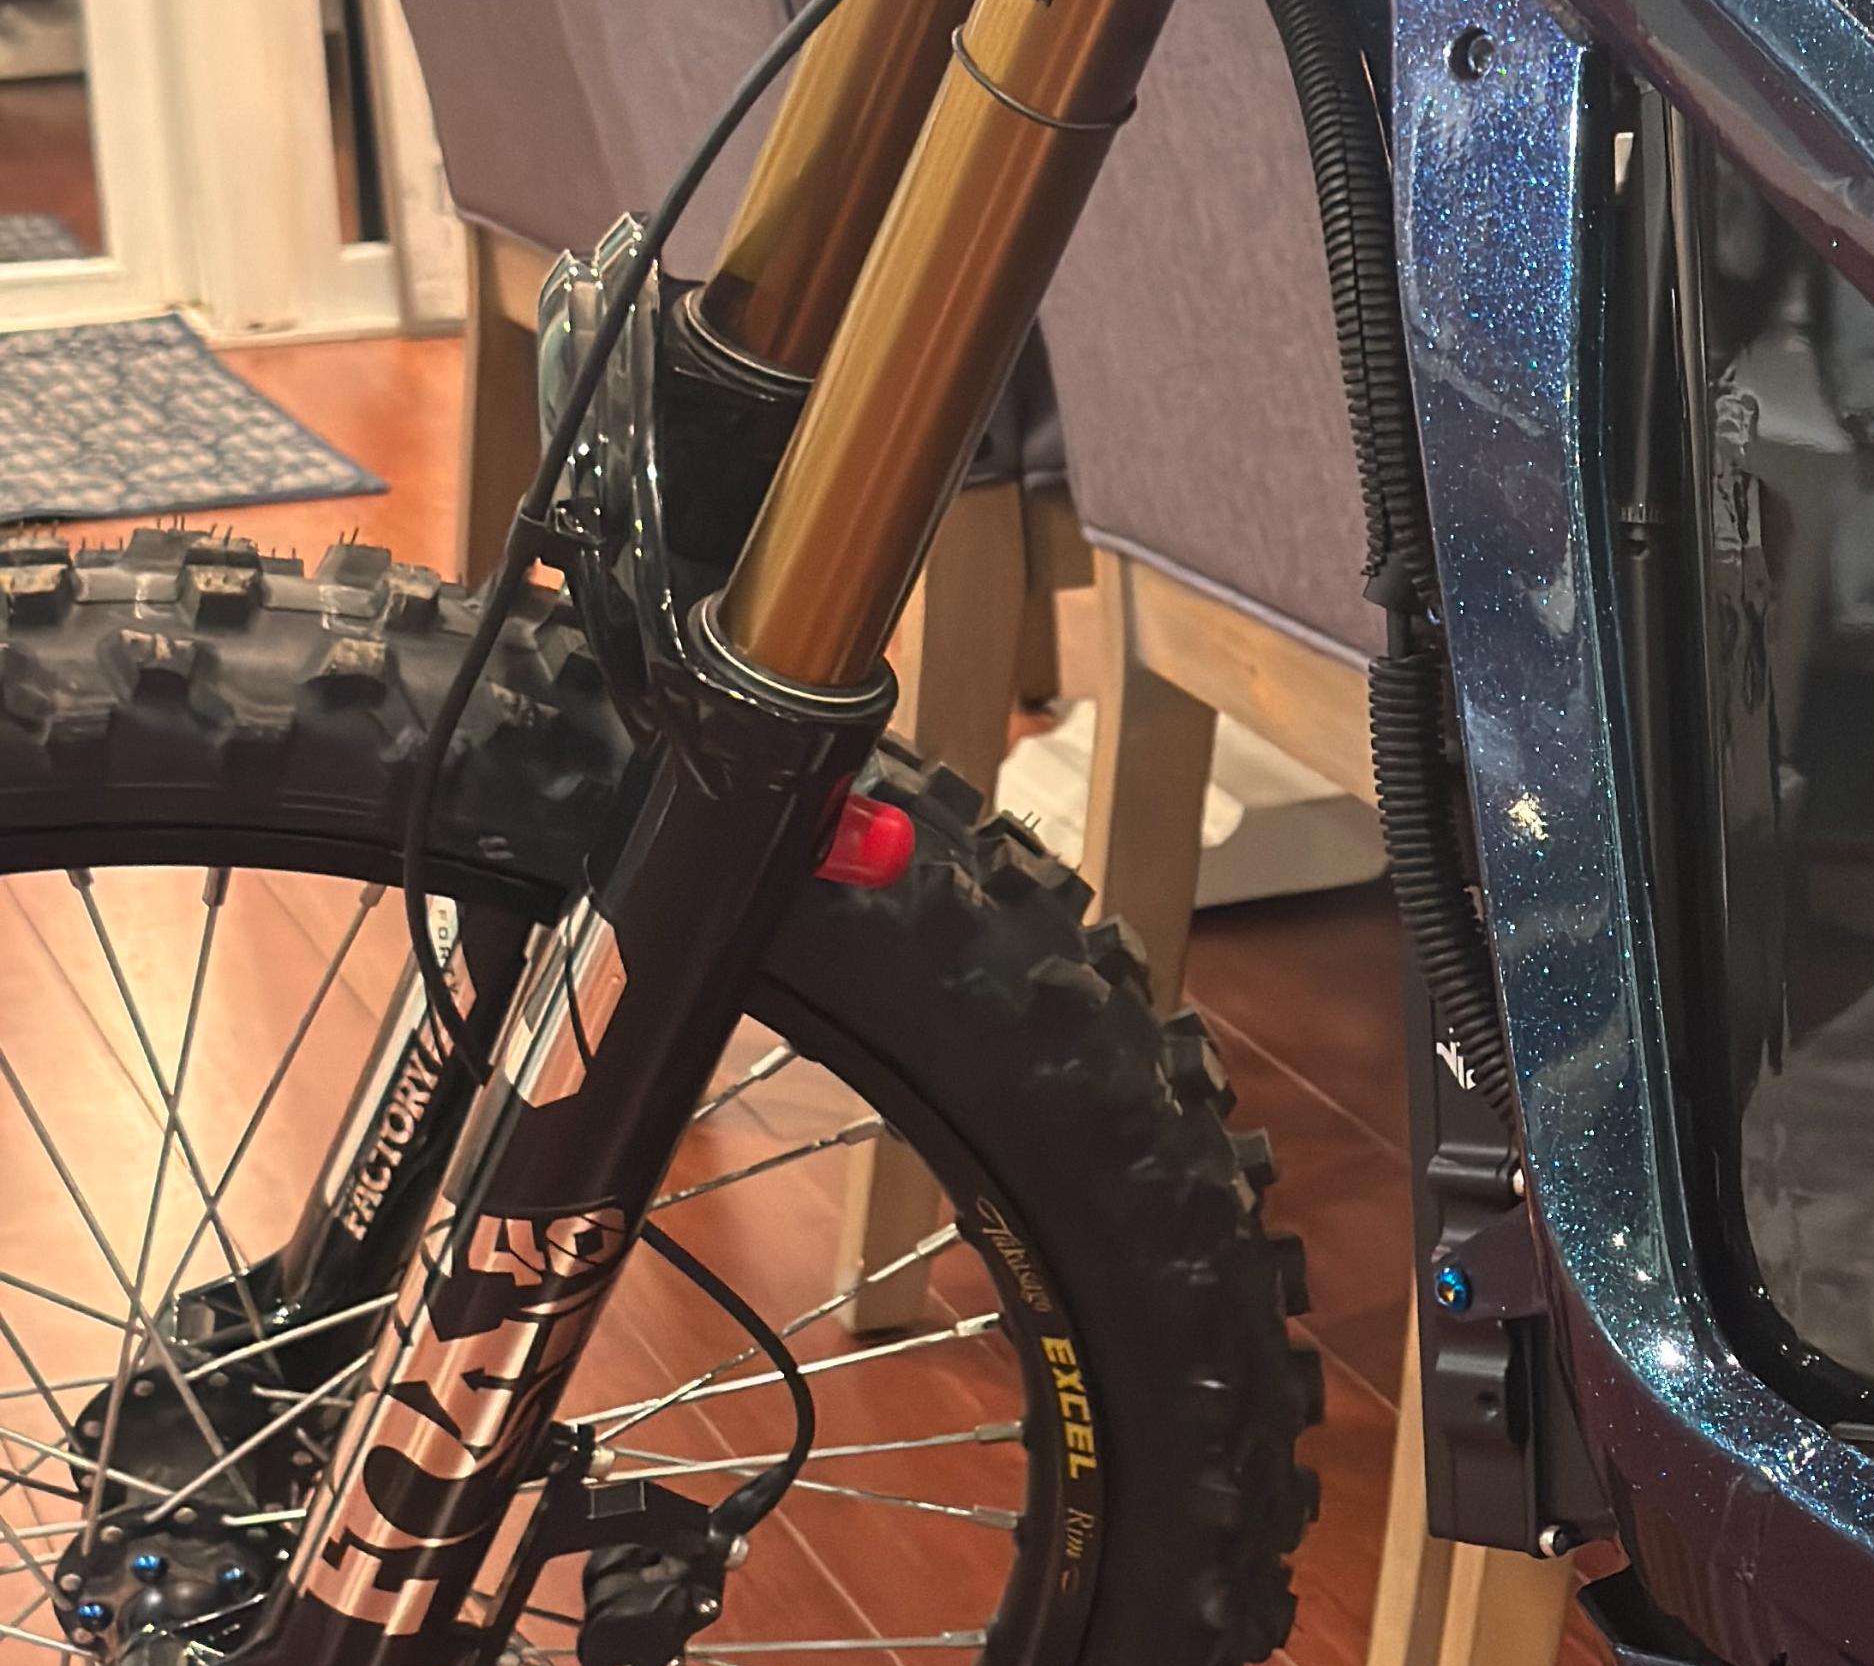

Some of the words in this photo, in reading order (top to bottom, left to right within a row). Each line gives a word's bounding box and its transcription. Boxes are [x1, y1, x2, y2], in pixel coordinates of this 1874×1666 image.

[343, 1044, 439, 1242] FACTORY
[468, 1207, 627, 1288] 40
[1041, 1335, 1098, 1481] EXCEL
